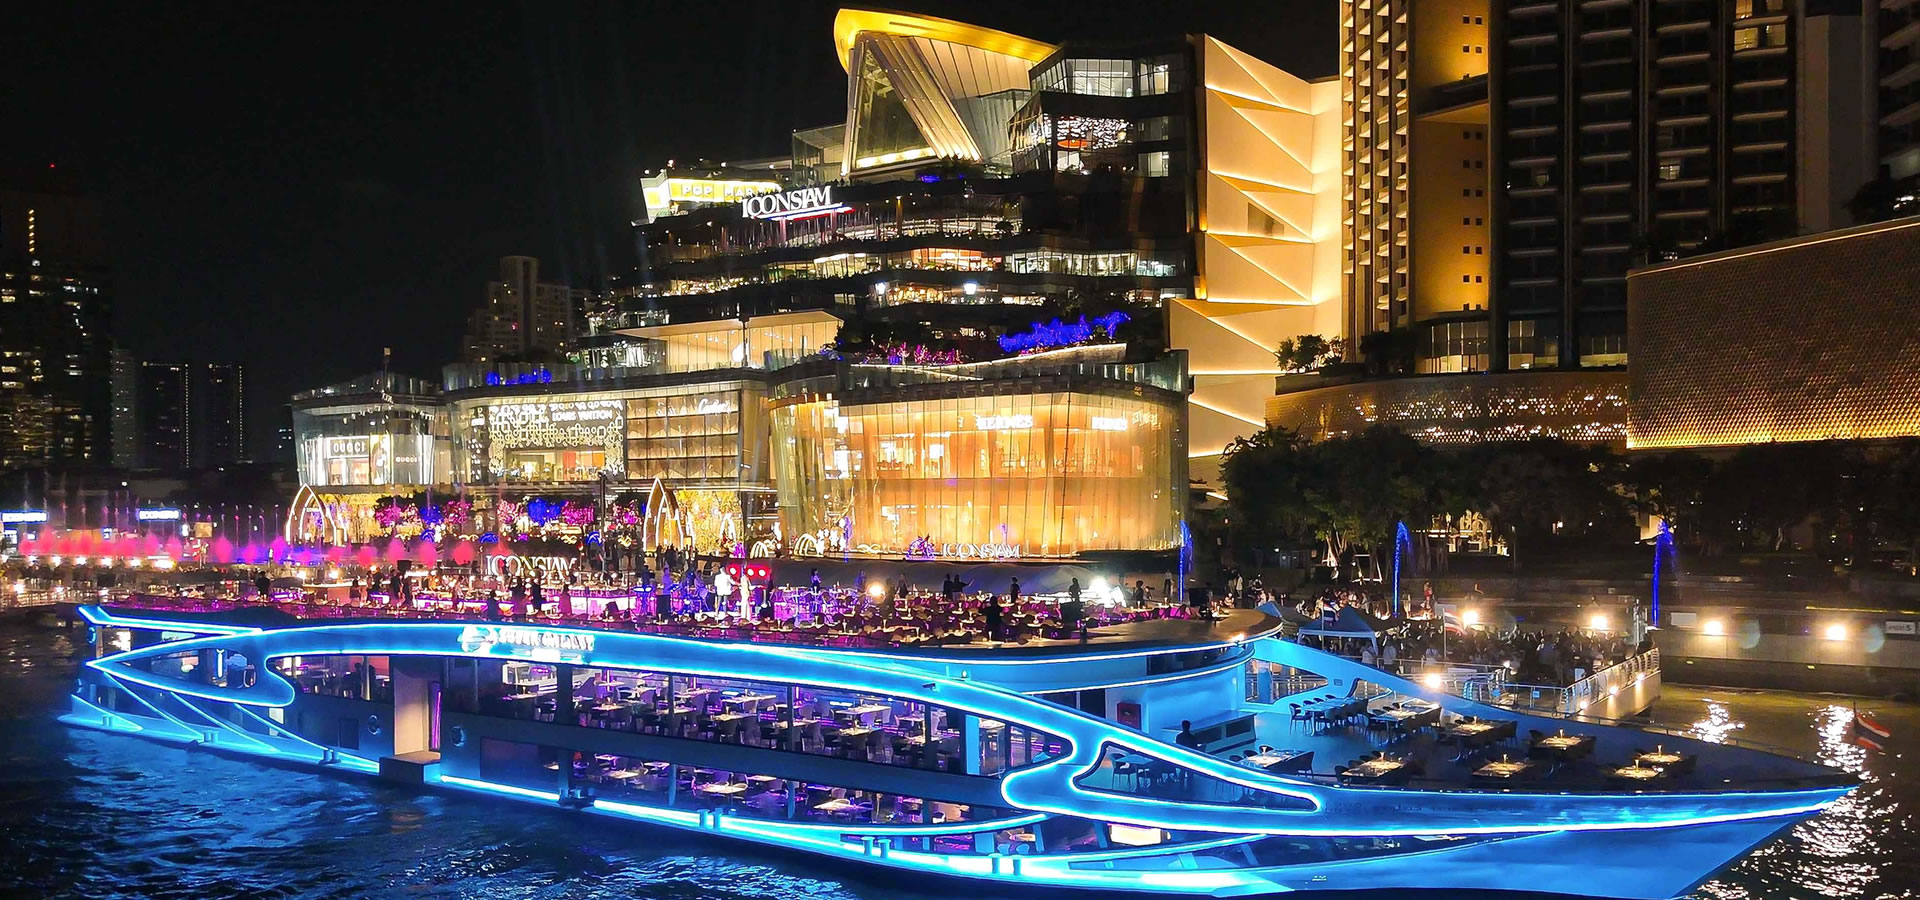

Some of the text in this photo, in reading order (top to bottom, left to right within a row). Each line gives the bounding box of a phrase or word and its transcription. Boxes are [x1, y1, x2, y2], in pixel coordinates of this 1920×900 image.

[682, 185, 713, 196] POP
[740, 185, 832, 218] ICONSIAM
[552, 411, 577, 422] LOUIS
[941, 543, 1020, 559] ICONSIAM
[485, 555, 578, 580] ICONSIAM
